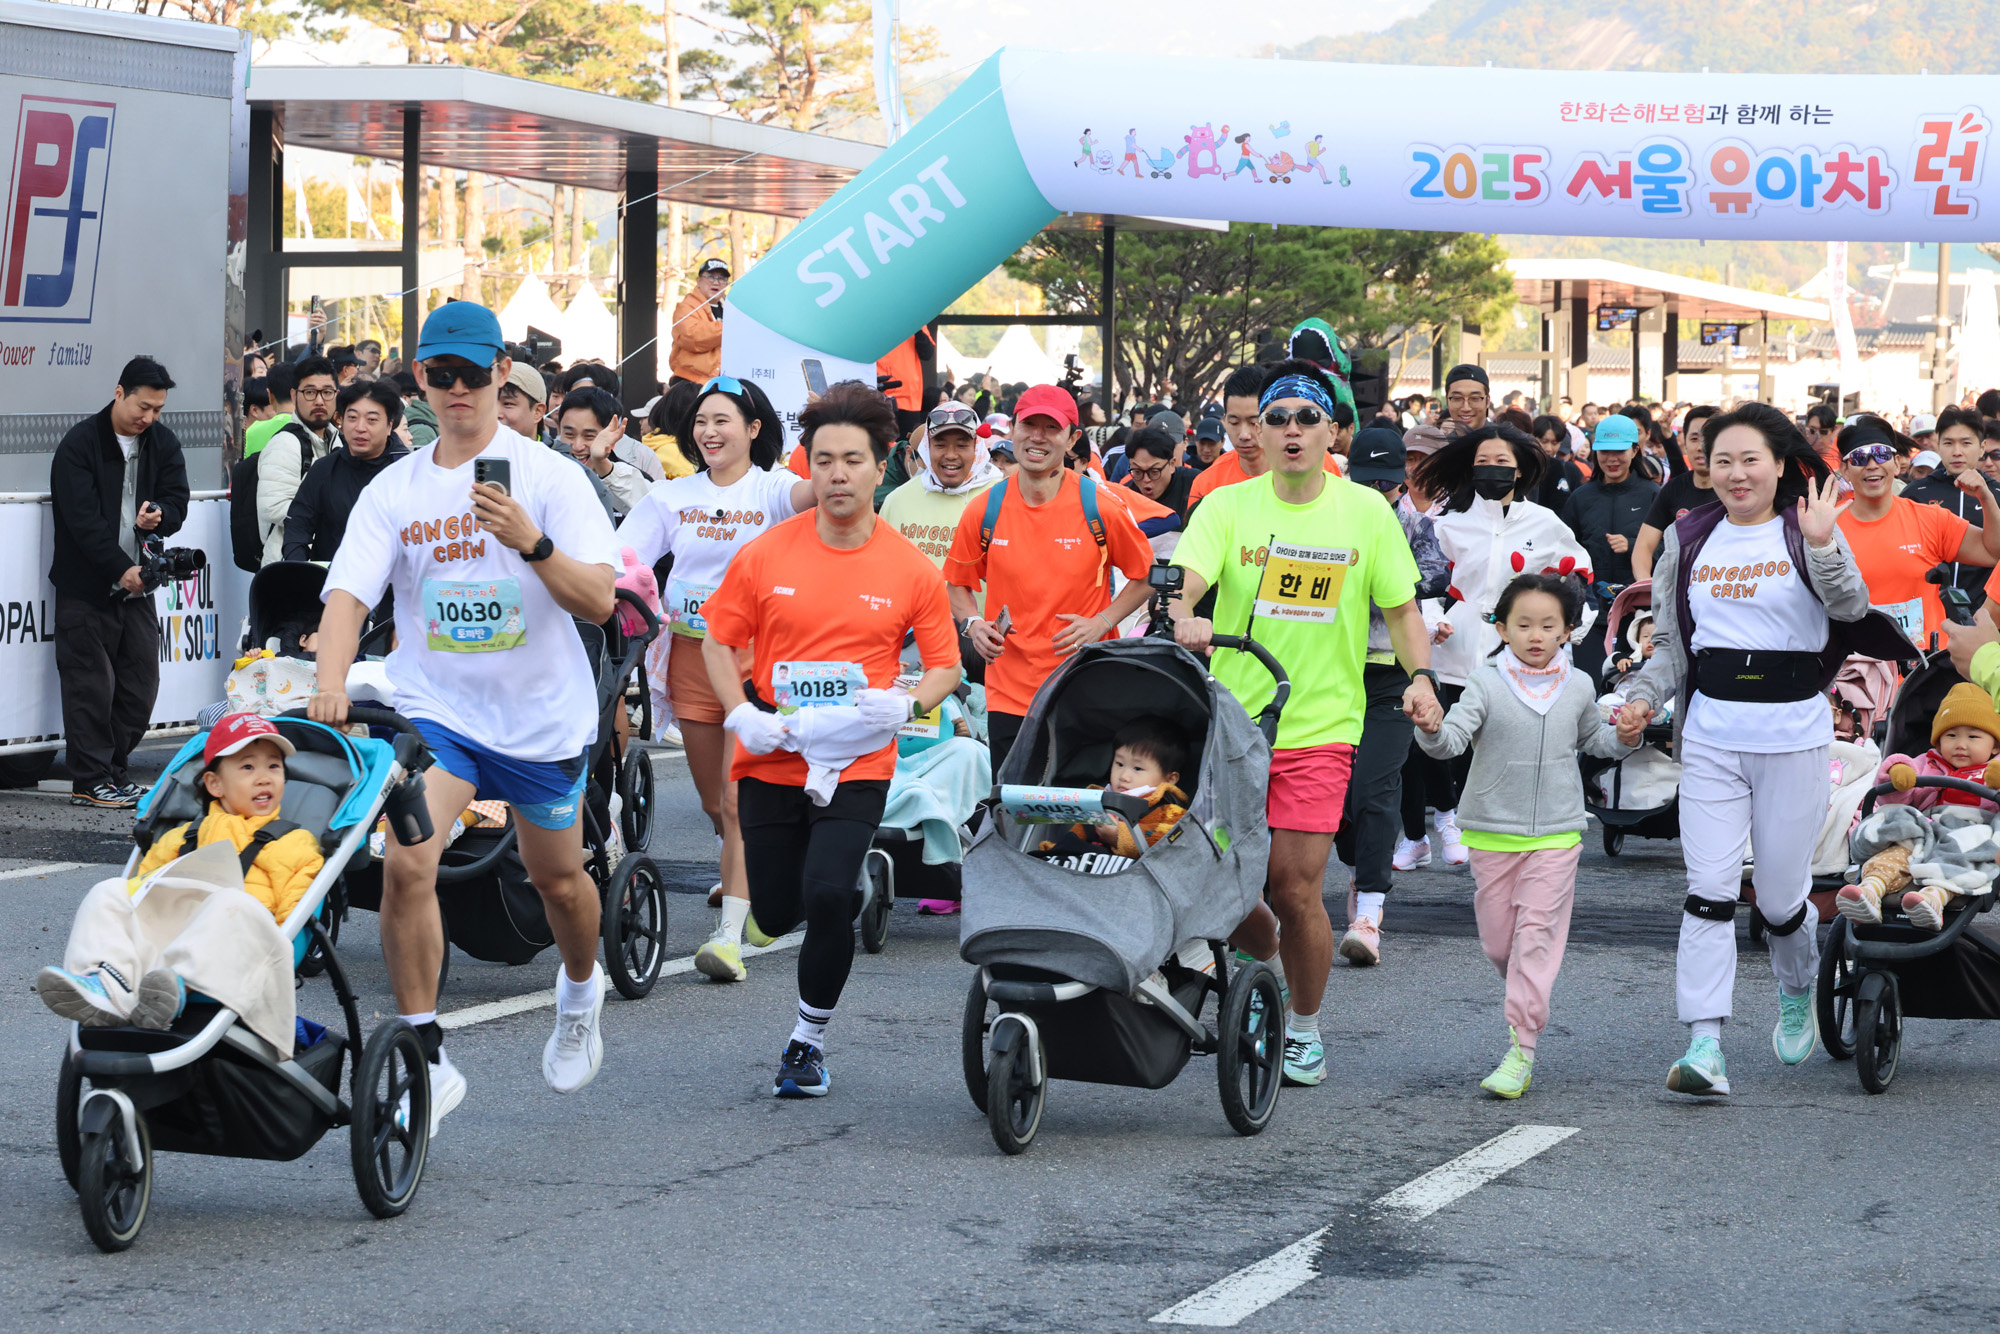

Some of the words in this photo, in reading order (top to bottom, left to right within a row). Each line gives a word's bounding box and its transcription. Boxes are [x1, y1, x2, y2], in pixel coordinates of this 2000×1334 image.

[1559, 101, 1729, 125] 한화손해보험과
[1737, 104, 1781, 125] 함께
[1790, 104, 1834, 125] 하는
[1410, 151, 1542, 200] 2025
[1566, 144, 1687, 213] 서울
[1709, 146, 1889, 213] 유아차
[1913, 113, 1983, 215] 런
[797, 155, 967, 308] START
[48, 342, 93, 366] family
[697, 526, 737, 541] CREW
[433, 539, 485, 563] CREW
[1276, 546, 1297, 557] 아이와
[1298, 550, 1311, 559] 함께
[1312, 551, 1328, 560] 달리고
[1690, 561, 1790, 586] KANGAROO
[1711, 583, 1757, 599] CREW
[0, 600, 55, 645] PAL
[437, 601, 502, 622] 10630
[184, 613, 221, 661] SOUL
[791, 680, 847, 697] 10183
